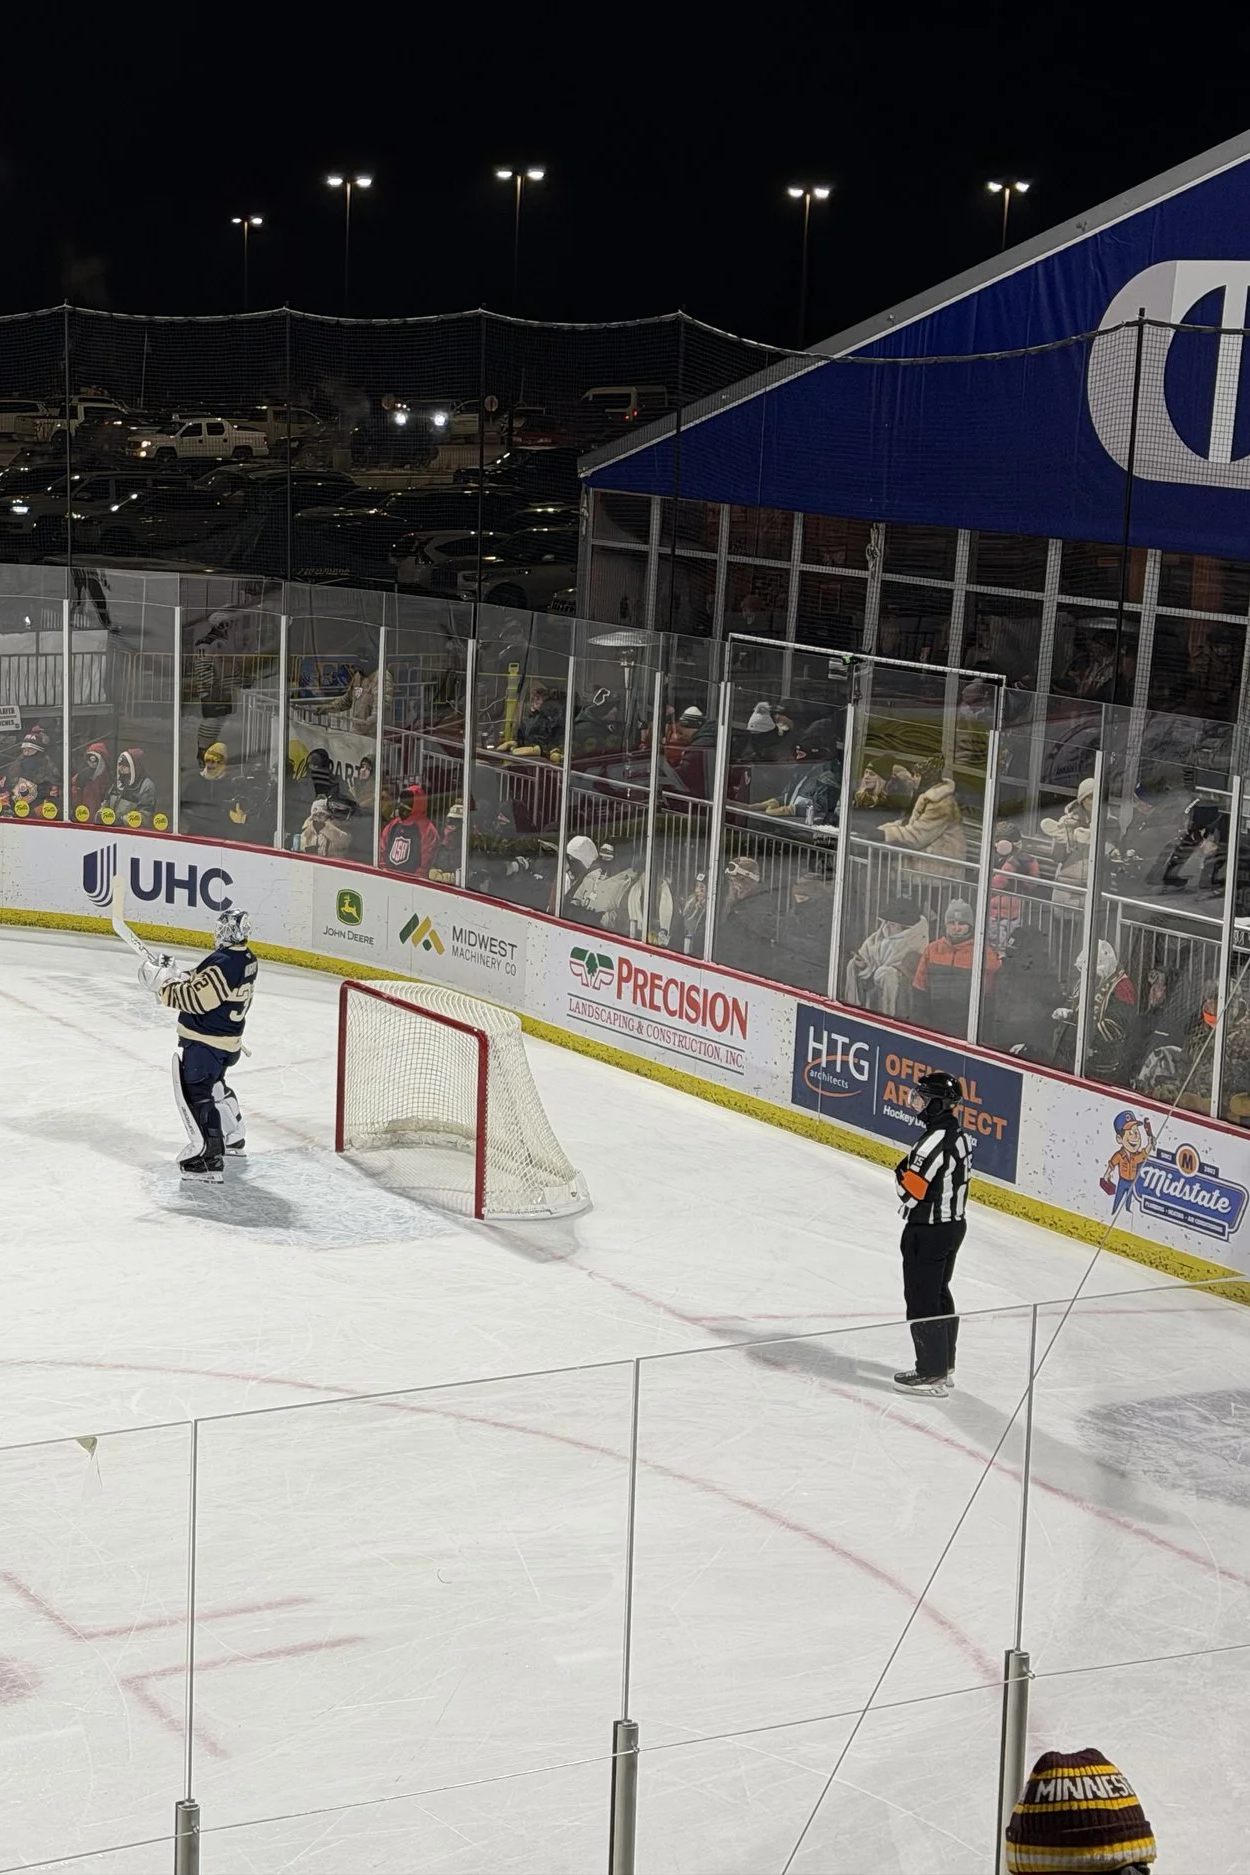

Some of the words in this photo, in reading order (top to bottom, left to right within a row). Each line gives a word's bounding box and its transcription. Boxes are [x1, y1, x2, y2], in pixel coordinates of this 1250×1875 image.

[130, 857, 234, 912] UHC
[322, 926, 346, 939] JOHN
[347, 931, 375, 946] DEERE
[452, 925, 518, 961] MIDWEST
[452, 945, 502, 971] MACHINERY
[505, 963, 517, 976] CO
[616, 956, 749, 1041] PRECISION
[569, 998, 635, 1032] LANDSCAPING
[636, 1021, 644, 1036] &
[646, 1024, 723, 1062] CONSTRUCTION,
[726, 1051, 745, 1069] INC.
[807, 1026, 870, 1082] HTG
[809, 1069, 849, 1089] architects
[885, 1053, 983, 1104] OFFAL
[883, 1081, 1008, 1140] ARTECT
[883, 1105, 915, 1127] Hockey
[913, 1155, 925, 1168] 15
[1181, 1152, 1194, 1171] M
[1140, 1166, 1232, 1214] Midstate
